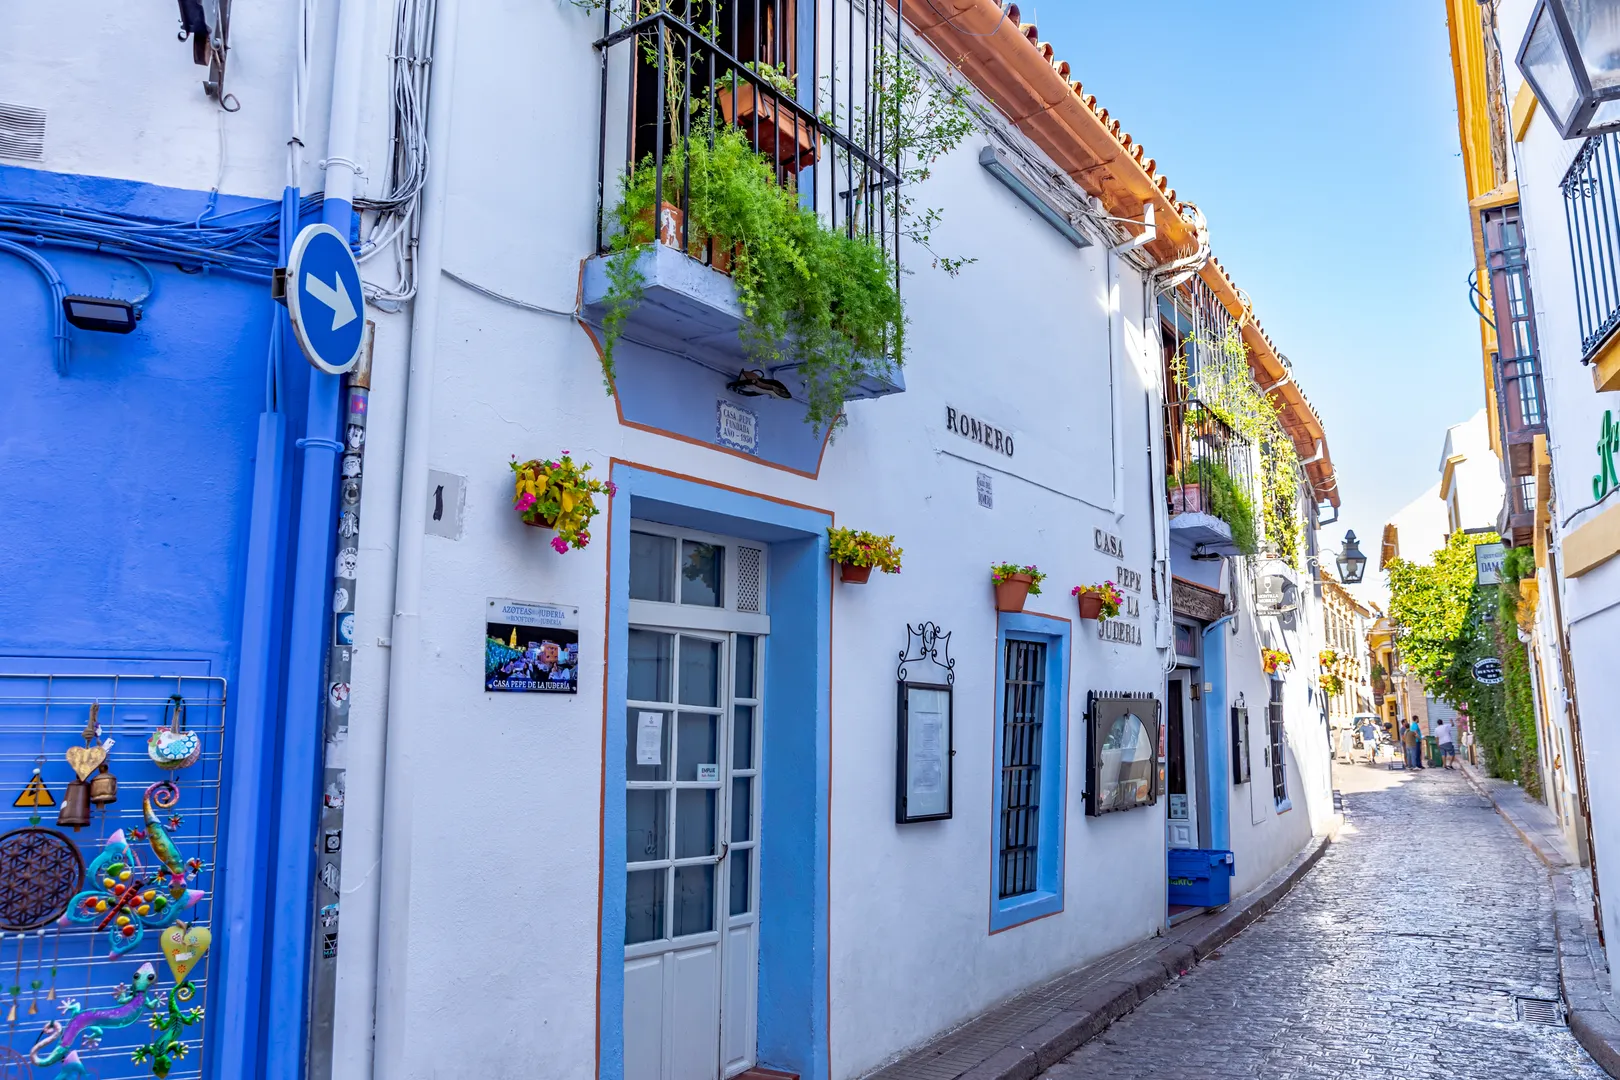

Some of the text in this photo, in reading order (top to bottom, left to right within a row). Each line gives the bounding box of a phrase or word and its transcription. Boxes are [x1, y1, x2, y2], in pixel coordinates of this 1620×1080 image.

[946, 405, 1014, 457] ROMERO
[432, 484, 445, 522] 1
[1096, 529, 1124, 558] CASA
[1116, 566, 1141, 591] PEPE
[502, 605, 533, 615] AZOTEAS
[1127, 596, 1139, 617] LA
[493, 680, 509, 688] CASA
